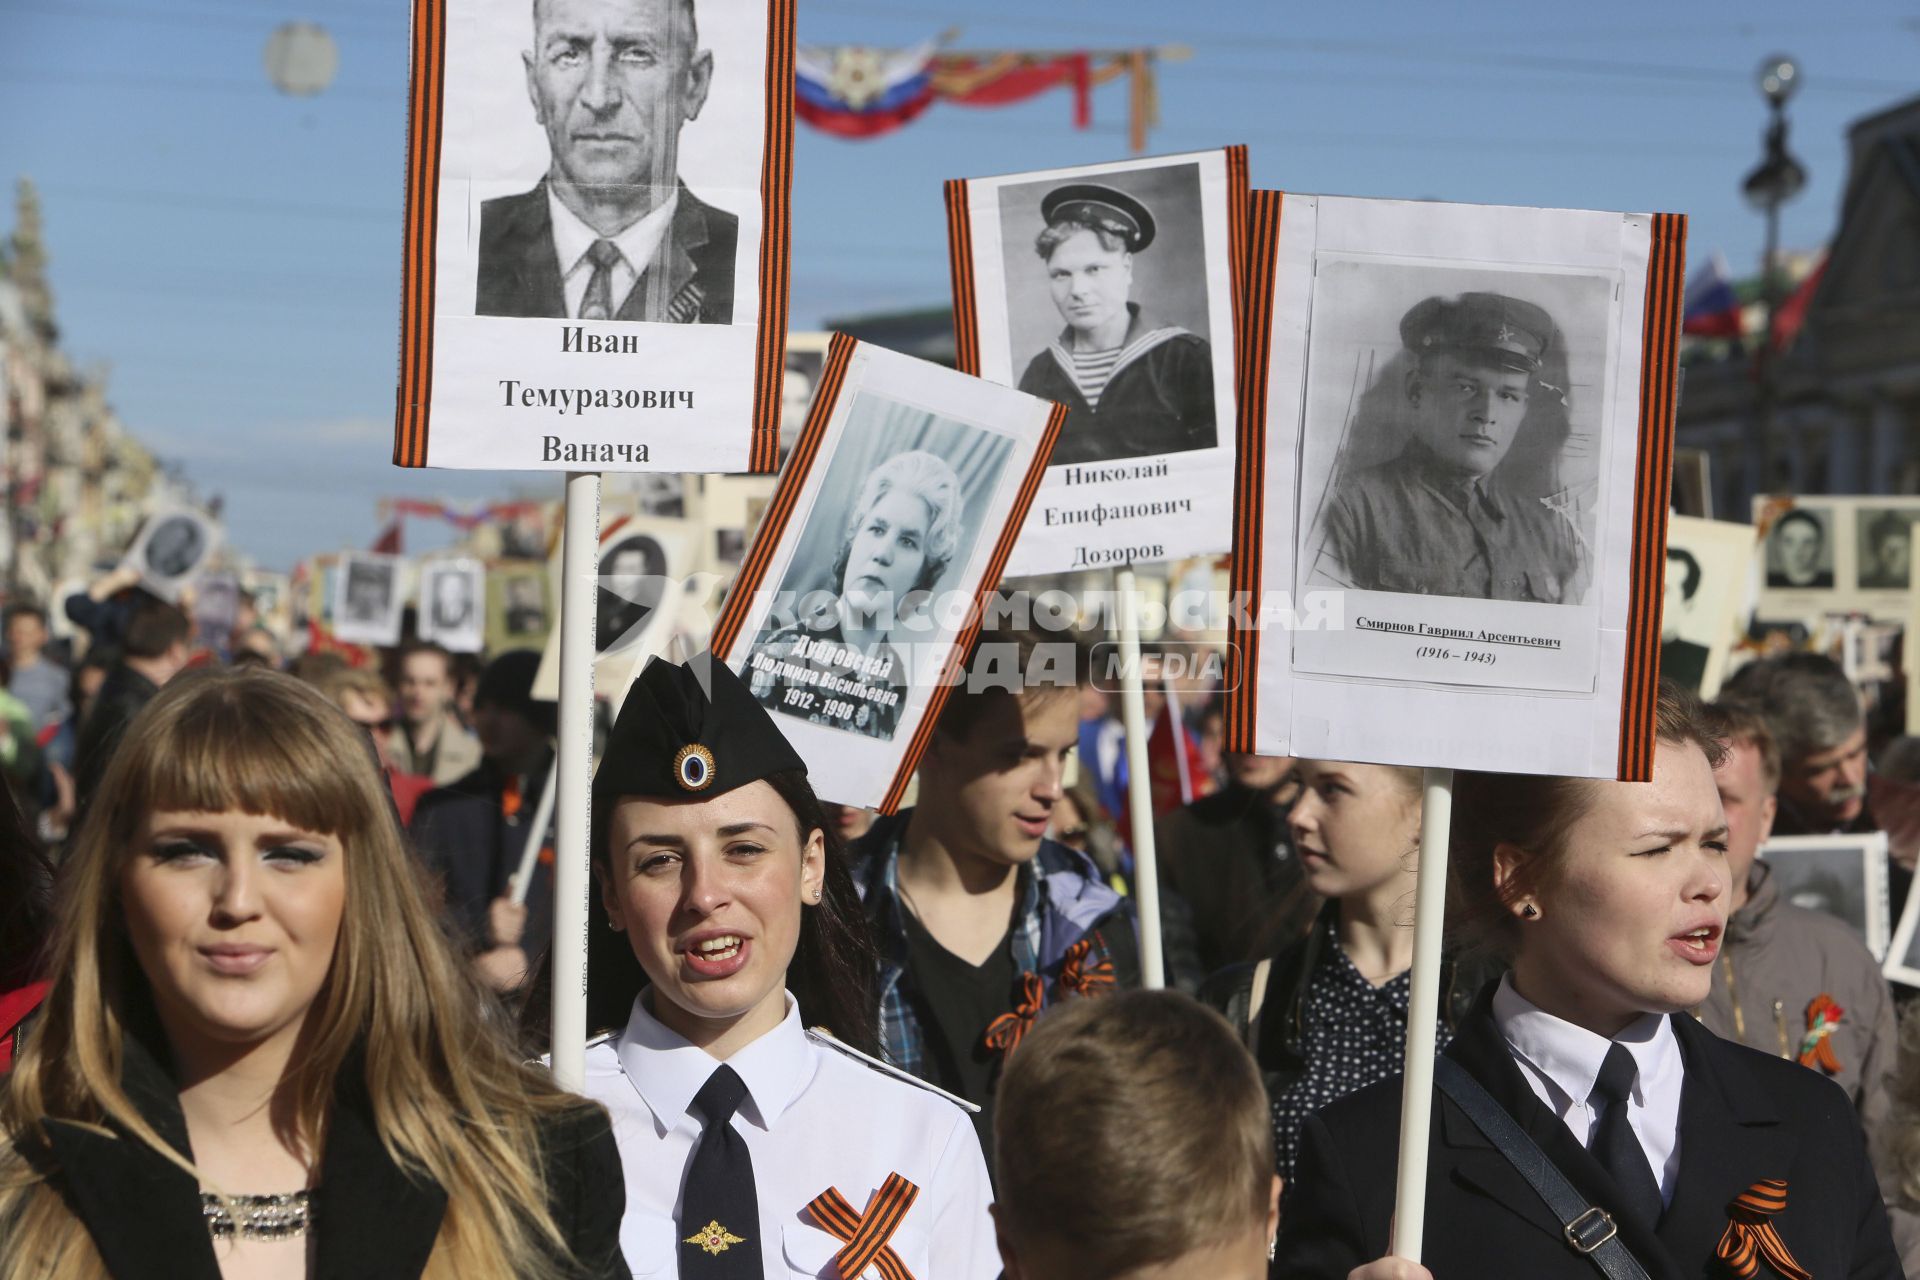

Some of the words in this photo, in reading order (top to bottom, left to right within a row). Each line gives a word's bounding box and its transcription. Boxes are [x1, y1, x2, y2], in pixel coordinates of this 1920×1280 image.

[560, 326, 639, 354] Иван
[498, 380, 695, 415] Темуразович
[541, 435, 650, 463] Ванача
[1065, 458, 1169, 486] Николай
[1044, 498, 1192, 527] Епифанович
[1071, 543, 1164, 568] Дозоров
[1356, 616, 1415, 633] Смирнов
[1418, 623, 1474, 640] Гавриил
[1477, 629, 1561, 648] Арсентьевич
[1416, 646, 1450, 660] (1916
[1463, 650, 1497, 666] 1943)
[751, 652, 818, 686] Людмила
[819, 671, 899, 707] Васильевна
[783, 688, 815, 710] 1912
[822, 698, 855, 721] 1998
